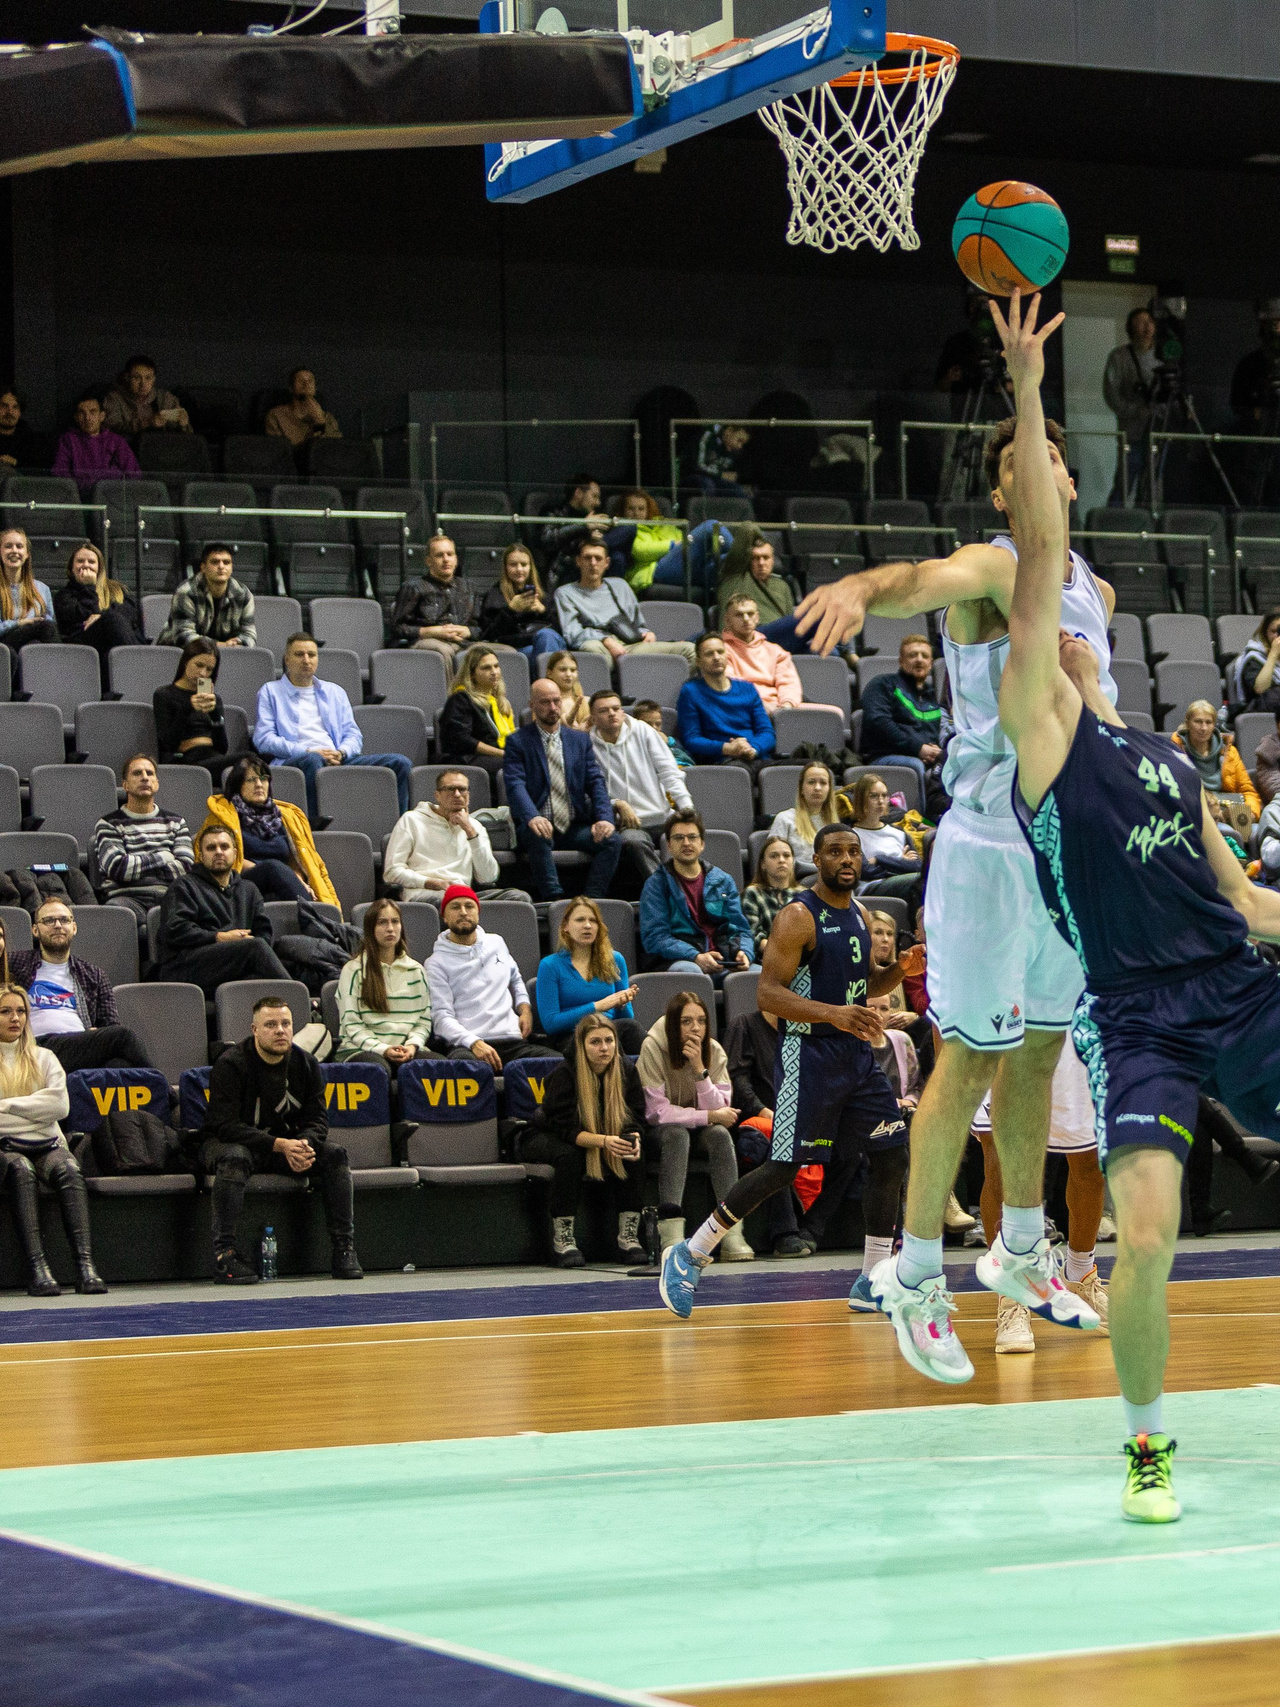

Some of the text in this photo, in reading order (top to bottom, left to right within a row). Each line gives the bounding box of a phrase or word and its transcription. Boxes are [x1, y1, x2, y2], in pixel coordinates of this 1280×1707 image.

[1137, 756, 1181, 799] 44
[849, 936, 862, 963] 3
[28, 994, 74, 1008] NASA
[91, 1086, 152, 1116] VIP
[324, 1083, 371, 1110] VIP
[421, 1078, 480, 1106] VIP
